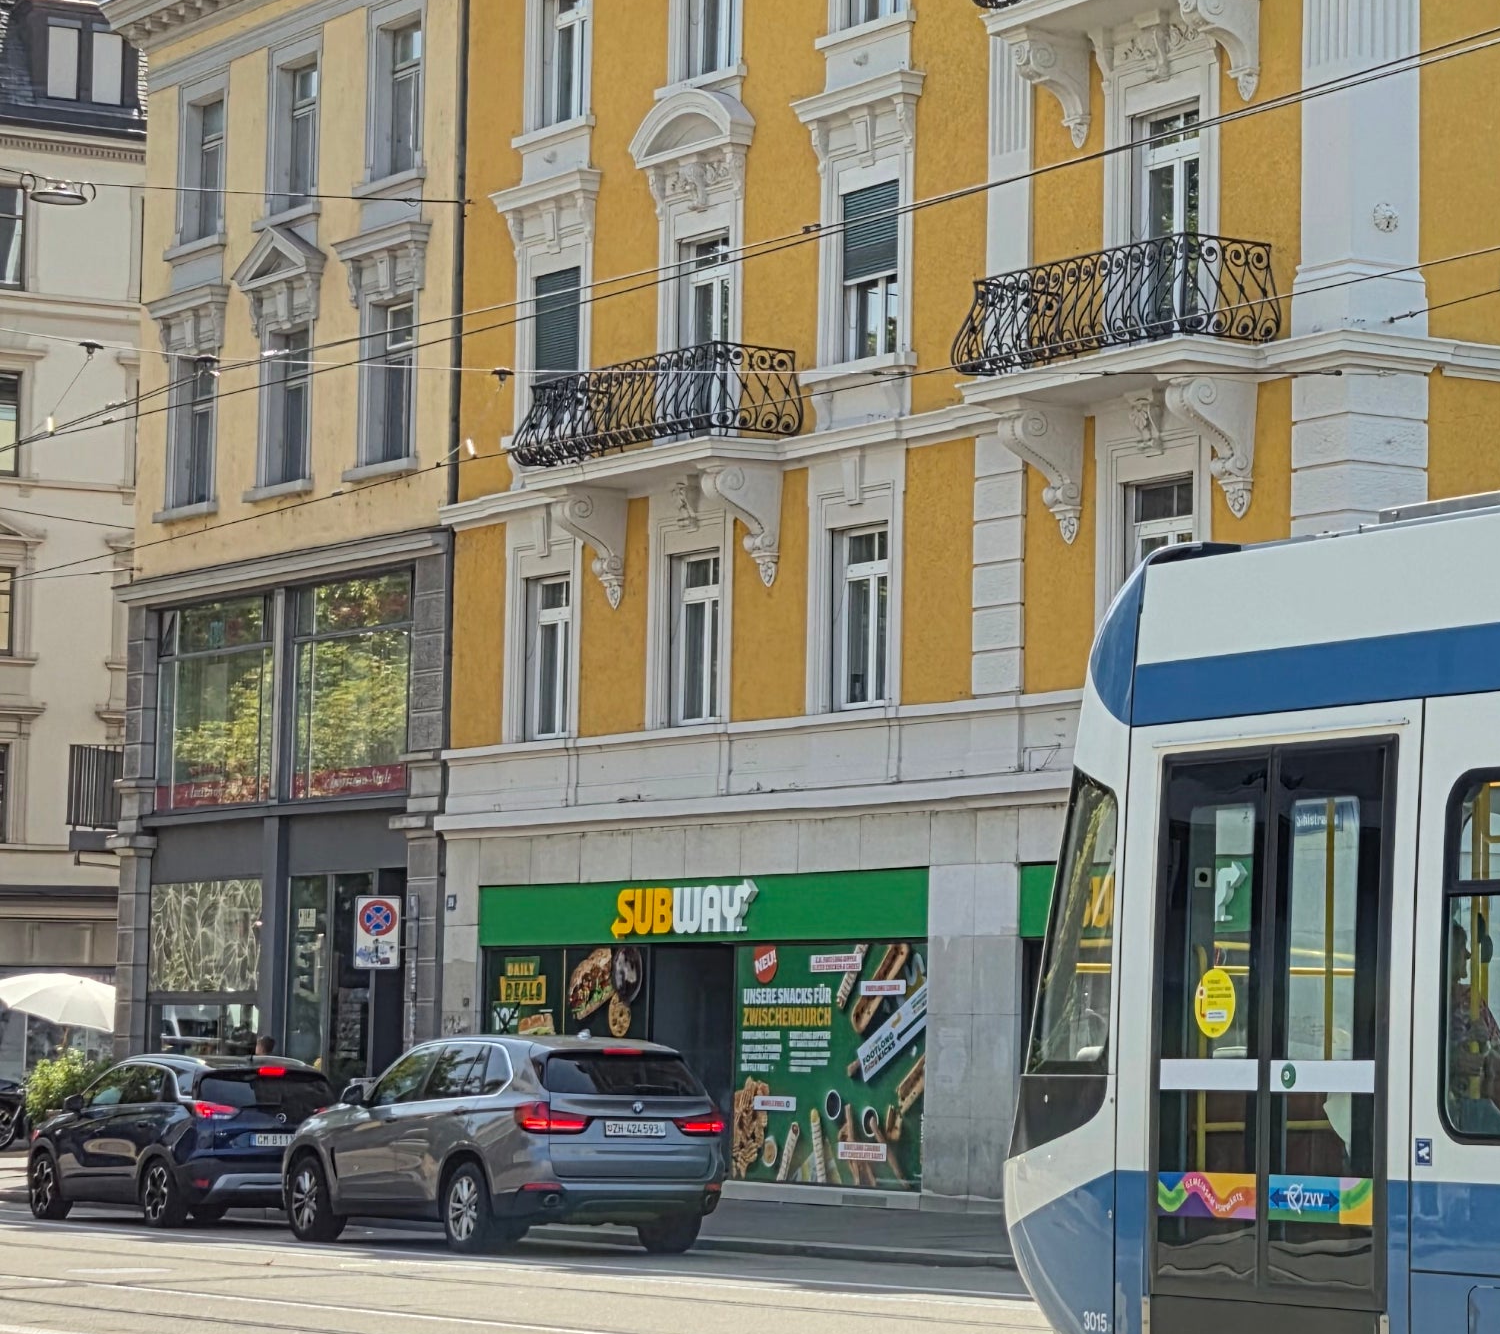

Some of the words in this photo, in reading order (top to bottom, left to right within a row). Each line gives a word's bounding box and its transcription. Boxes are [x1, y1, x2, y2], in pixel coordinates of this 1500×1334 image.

[611, 879, 759, 939] SUBWAY
[507, 962, 535, 976] DAILY
[754, 949, 777, 975] NEU!
[743, 988, 776, 1004] UNSERE
[778, 988, 812, 1004] SNACKS
[814, 984, 831, 1004] FÜR
[743, 1007, 831, 1026] ZWISCHENDURCH
[612, 1123, 624, 1134] ZH
[1303, 1192, 1324, 1207] ZVV
[1083, 1310, 1108, 1332] 3015
